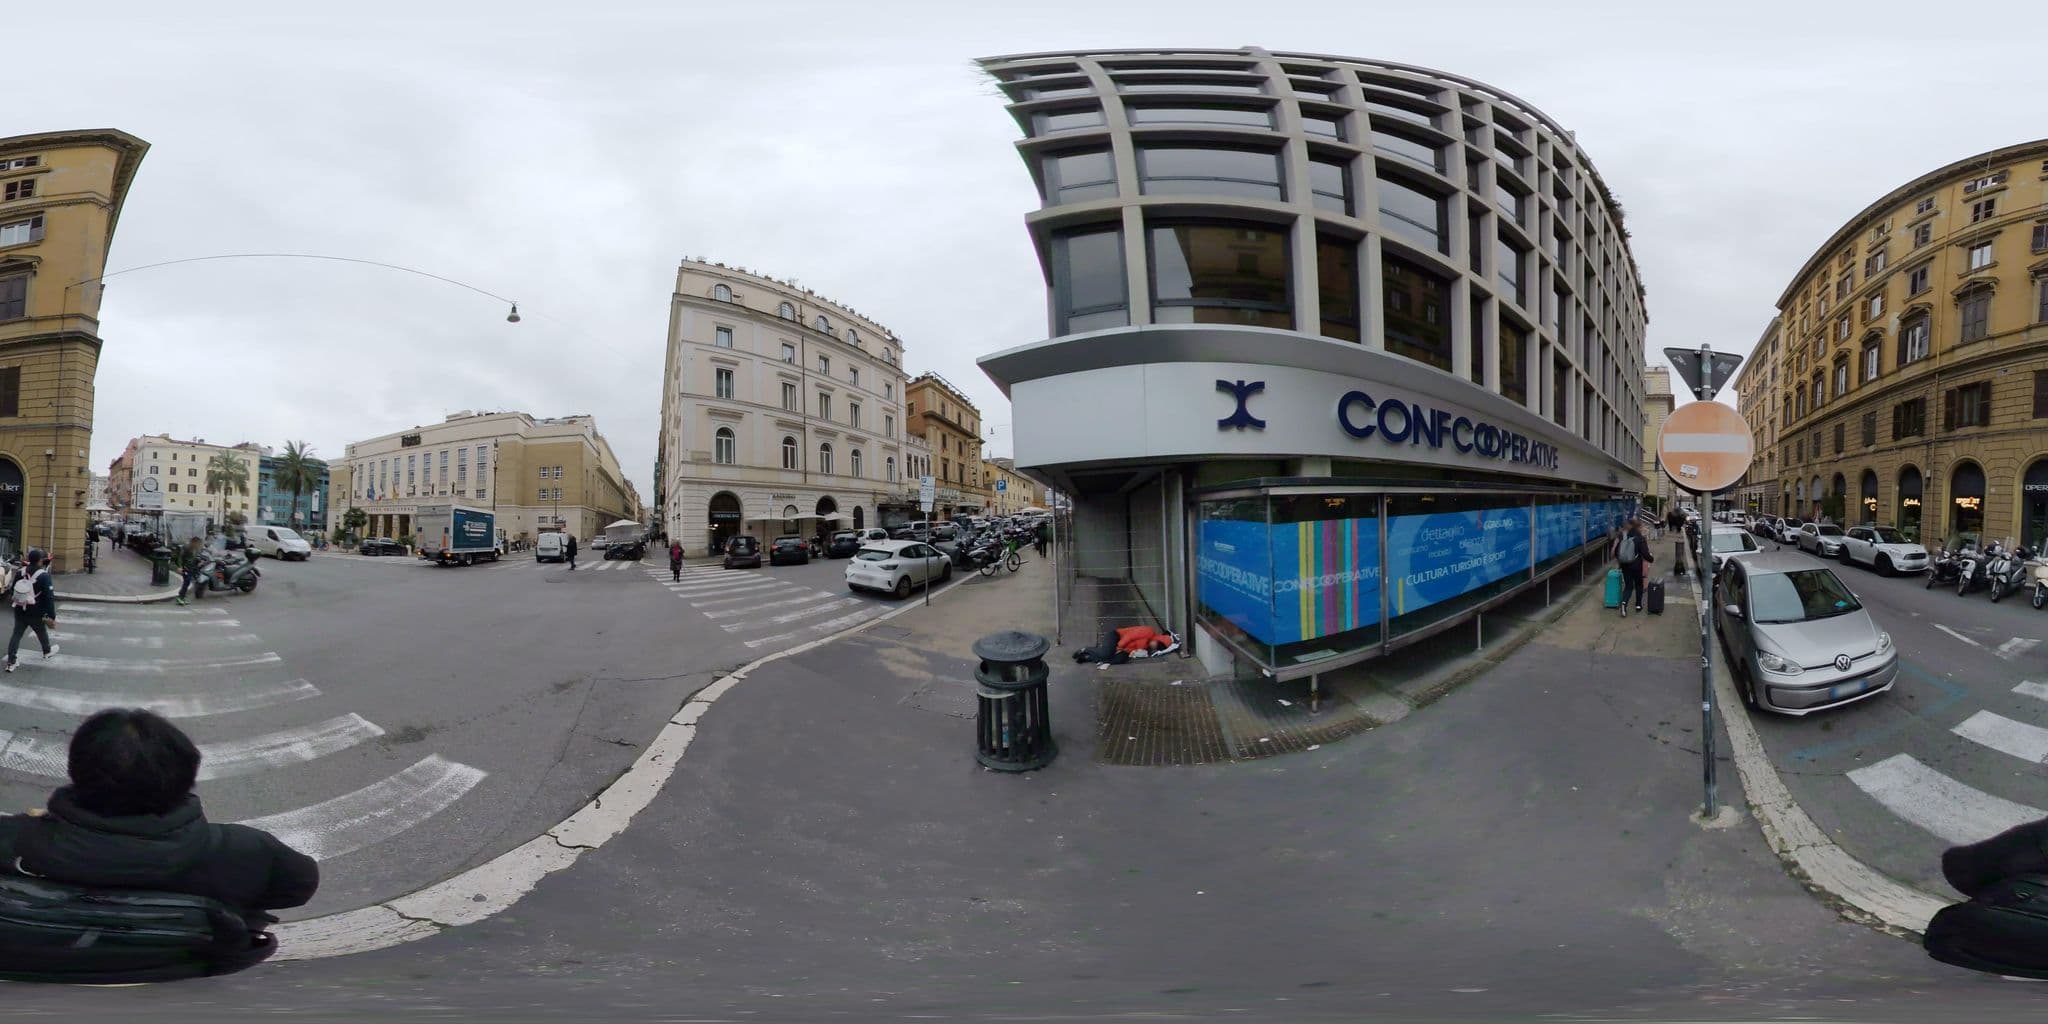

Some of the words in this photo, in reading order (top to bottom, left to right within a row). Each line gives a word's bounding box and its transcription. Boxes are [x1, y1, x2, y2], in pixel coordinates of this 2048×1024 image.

[1337, 390, 1559, 470] CONFCOOPERATIVE
[1274, 566, 1382, 593] CONFCOOPERATIVE
[1406, 566, 1449, 586] CULTURA
[1450, 556, 1482, 575] TURISMO
